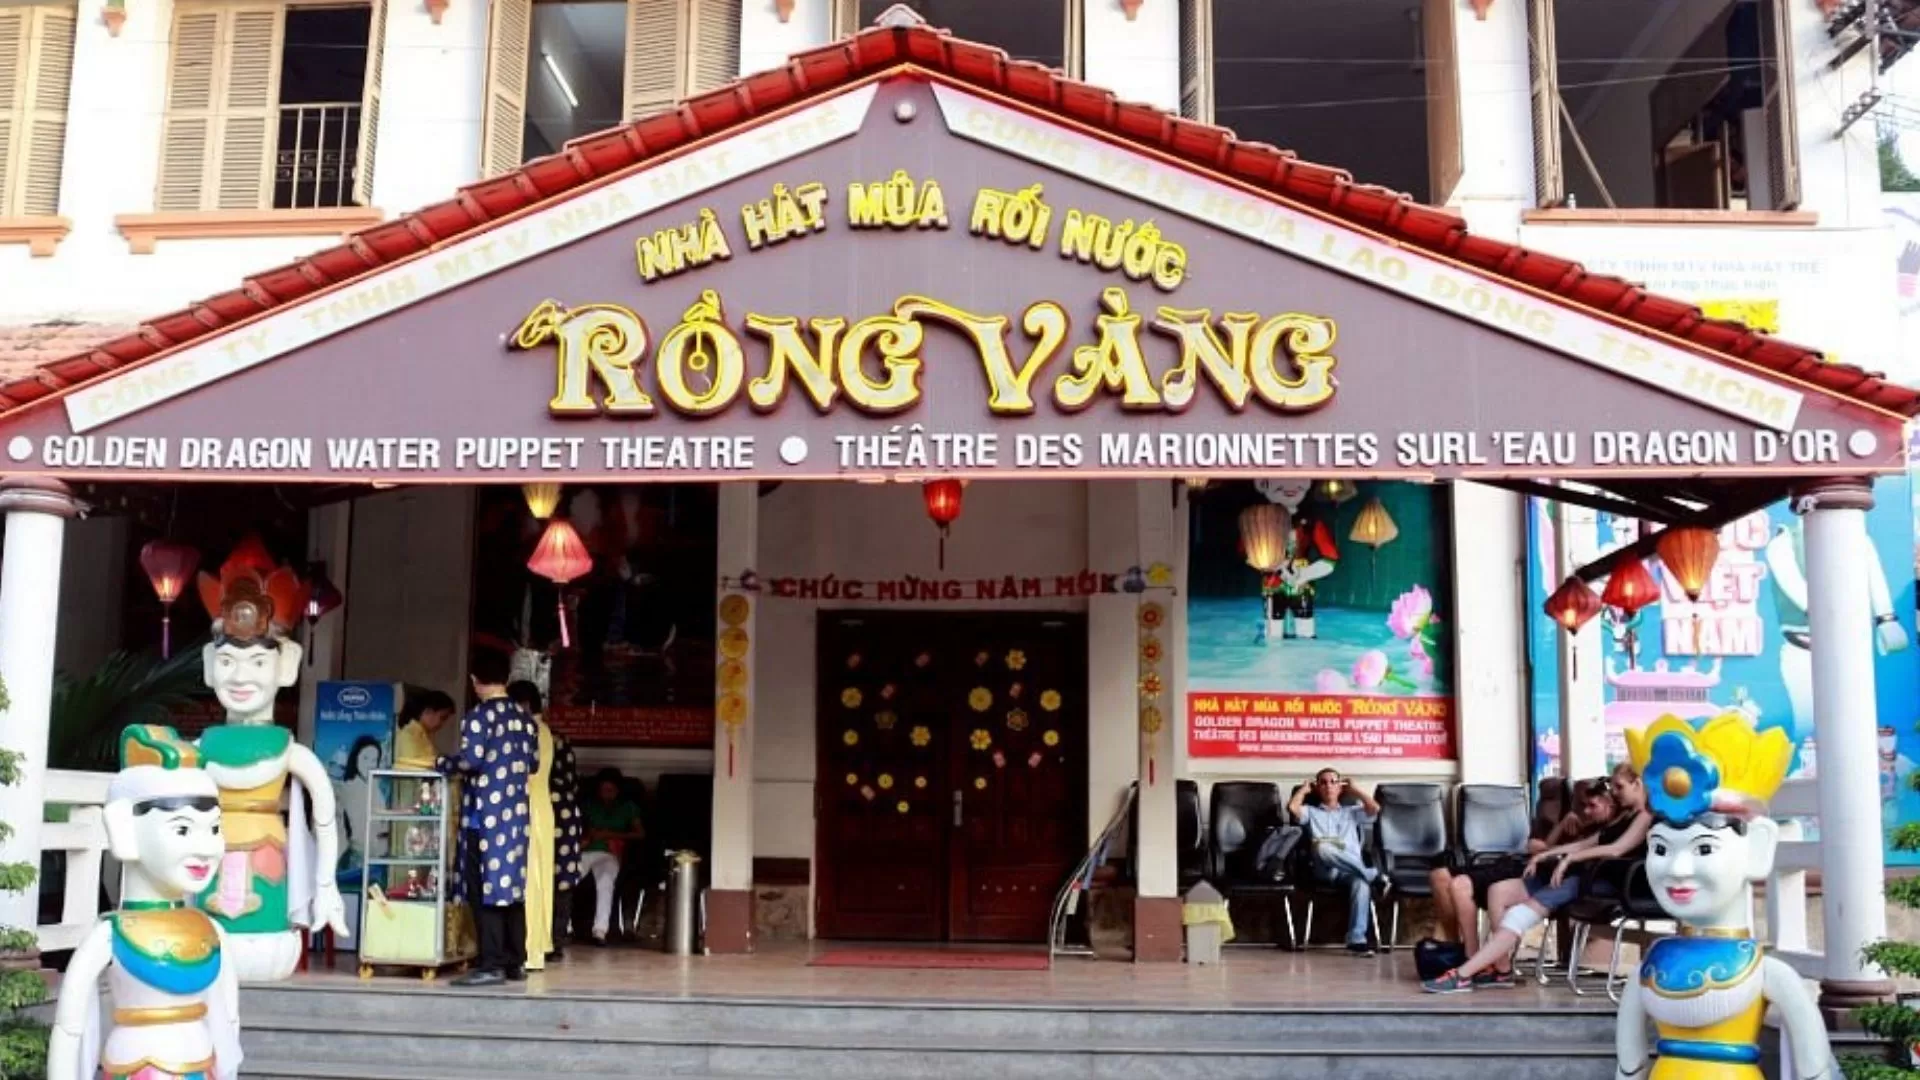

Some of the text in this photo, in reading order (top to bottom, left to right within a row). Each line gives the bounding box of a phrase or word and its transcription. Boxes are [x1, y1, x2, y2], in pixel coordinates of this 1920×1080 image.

[968, 107, 1080, 166] CUNG
[1321, 232, 1412, 281] LAO
[636, 170, 1187, 291] NHÀ HÁT MÚA RỐI NƯỚC
[217, 325, 272, 364] TY
[433, 226, 531, 283] MTV
[514, 287, 1338, 415] RỒNG VÀNG
[43, 436, 754, 469] GOLDEN DRAGON WATER PUPPET THEATRE
[835, 424, 998, 466] THÉÂTRE
[1016, 433, 1084, 467] DES
[1101, 432, 1380, 467] MARIONNETTES
[1594, 430, 1739, 465] DRAGON
[1754, 429, 1841, 463] D'OR
[776, 573, 863, 599] CHÚC
[878, 574, 962, 601] MỪNG
[976, 574, 1041, 600] NĂM
[1664, 616, 1763, 656] NAM
[1194, 716, 1242, 728] GOLDEN
[1298, 718, 1340, 730] WATER
[1344, 719, 1389, 732] PUPPET
[1393, 720, 1445, 732] THEATRE
[1239, 731, 1258, 742] DES
